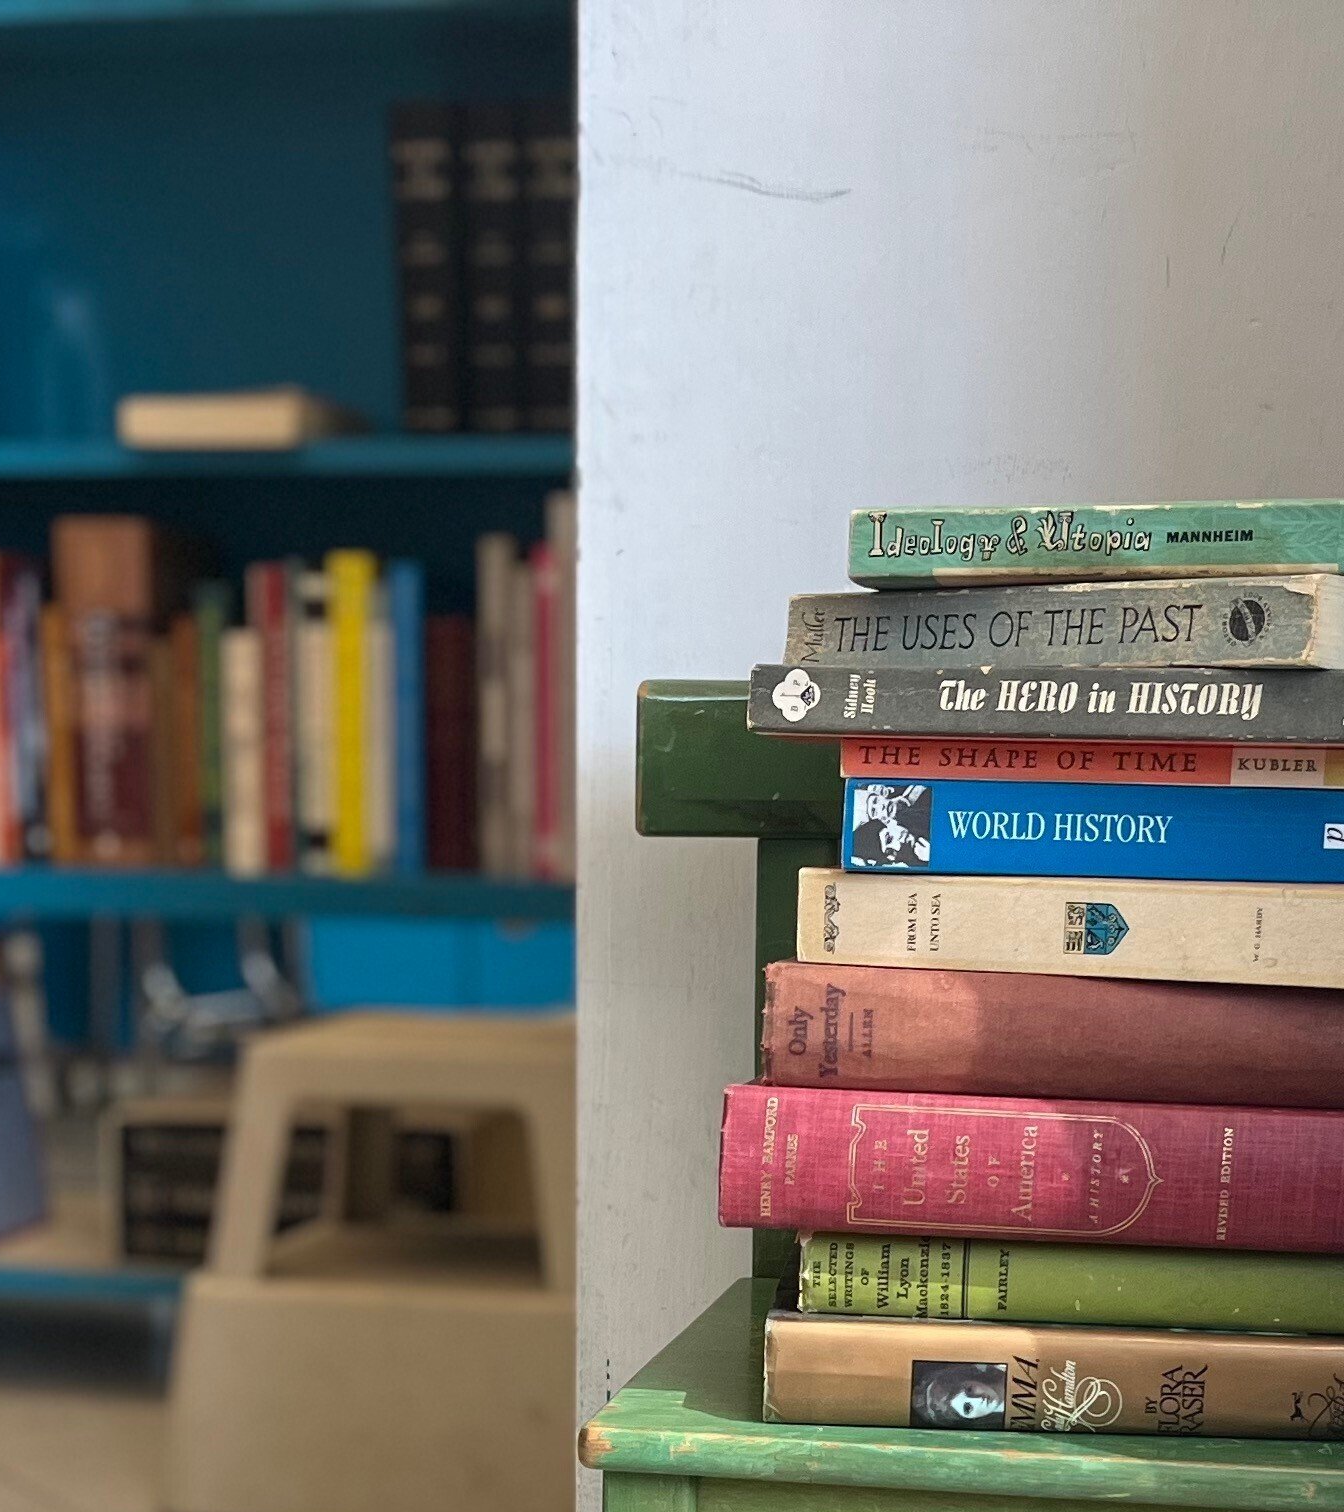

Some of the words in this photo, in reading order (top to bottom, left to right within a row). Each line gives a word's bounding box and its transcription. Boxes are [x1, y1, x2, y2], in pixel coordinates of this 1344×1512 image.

[868, 510, 1001, 561] Ideology
[1006, 515, 1028, 555] &
[1036, 510, 1152, 555] Utopia
[1166, 529, 1254, 543] MANNHEIM
[801, 606, 826, 663] Muller
[834, 615, 891, 652] THE
[902, 612, 977, 651] USES
[989, 609, 1033, 647] OF
[1044, 606, 1106, 646] THE
[1118, 603, 1203, 644] PAST
[843, 673, 861, 719] Sidney
[860, 677, 877, 715] Hook
[938, 679, 987, 712] The
[994, 680, 1079, 715] HERO
[1087, 681, 1116, 714] in
[1125, 681, 1264, 720] HISTORY
[859, 745, 921, 765] THE
[938, 747, 1037, 769] SHAPE
[1056, 750, 1095, 770] OF
[1113, 751, 1198, 773] TIME
[1237, 758, 1318, 772] KUBLER
[948, 810, 1045, 841] WORLD
[1053, 812, 1173, 844] HISTORY
[908, 892, 919, 915] SEA
[932, 893, 942, 915] SEA
[907, 918, 918, 952] FROM
[929, 917, 940, 952] UNTO
[788, 1005, 814, 1055] Only
[818, 983, 846, 1077] Yesterday
[862, 1008, 874, 1058] ALLEN
[762, 1097, 779, 1164] BAMFORD
[1220, 1127, 1234, 1184] EDITION
[785, 1134, 799, 1185] PARKES
[873, 1139, 888, 1192] THE
[902, 1128, 930, 1206] United
[947, 1135, 971, 1205] States
[987, 1154, 1001, 1188] OF
[1011, 1125, 1039, 1222] America
[1089, 1128, 1104, 1209] HISTORY
[760, 1170, 773, 1217] HENRY
[1216, 1189, 1230, 1241] REVISED
[812, 1260, 822, 1288] THE
[828, 1242, 839, 1307] SELECTED
[844, 1242, 855, 1308] WRITINGS
[860, 1267, 870, 1286] OF
[876, 1243, 891, 1309] William
[896, 1257, 912, 1299] Lyon
[939, 1242, 952, 1316] 1824-1837
[998, 1249, 1010, 1311] FAIRLEY
[1042, 1359, 1077, 1416] Hamilton
[1145, 1396, 1158, 1414] BY
[1158, 1364, 1184, 1432] FLORA
